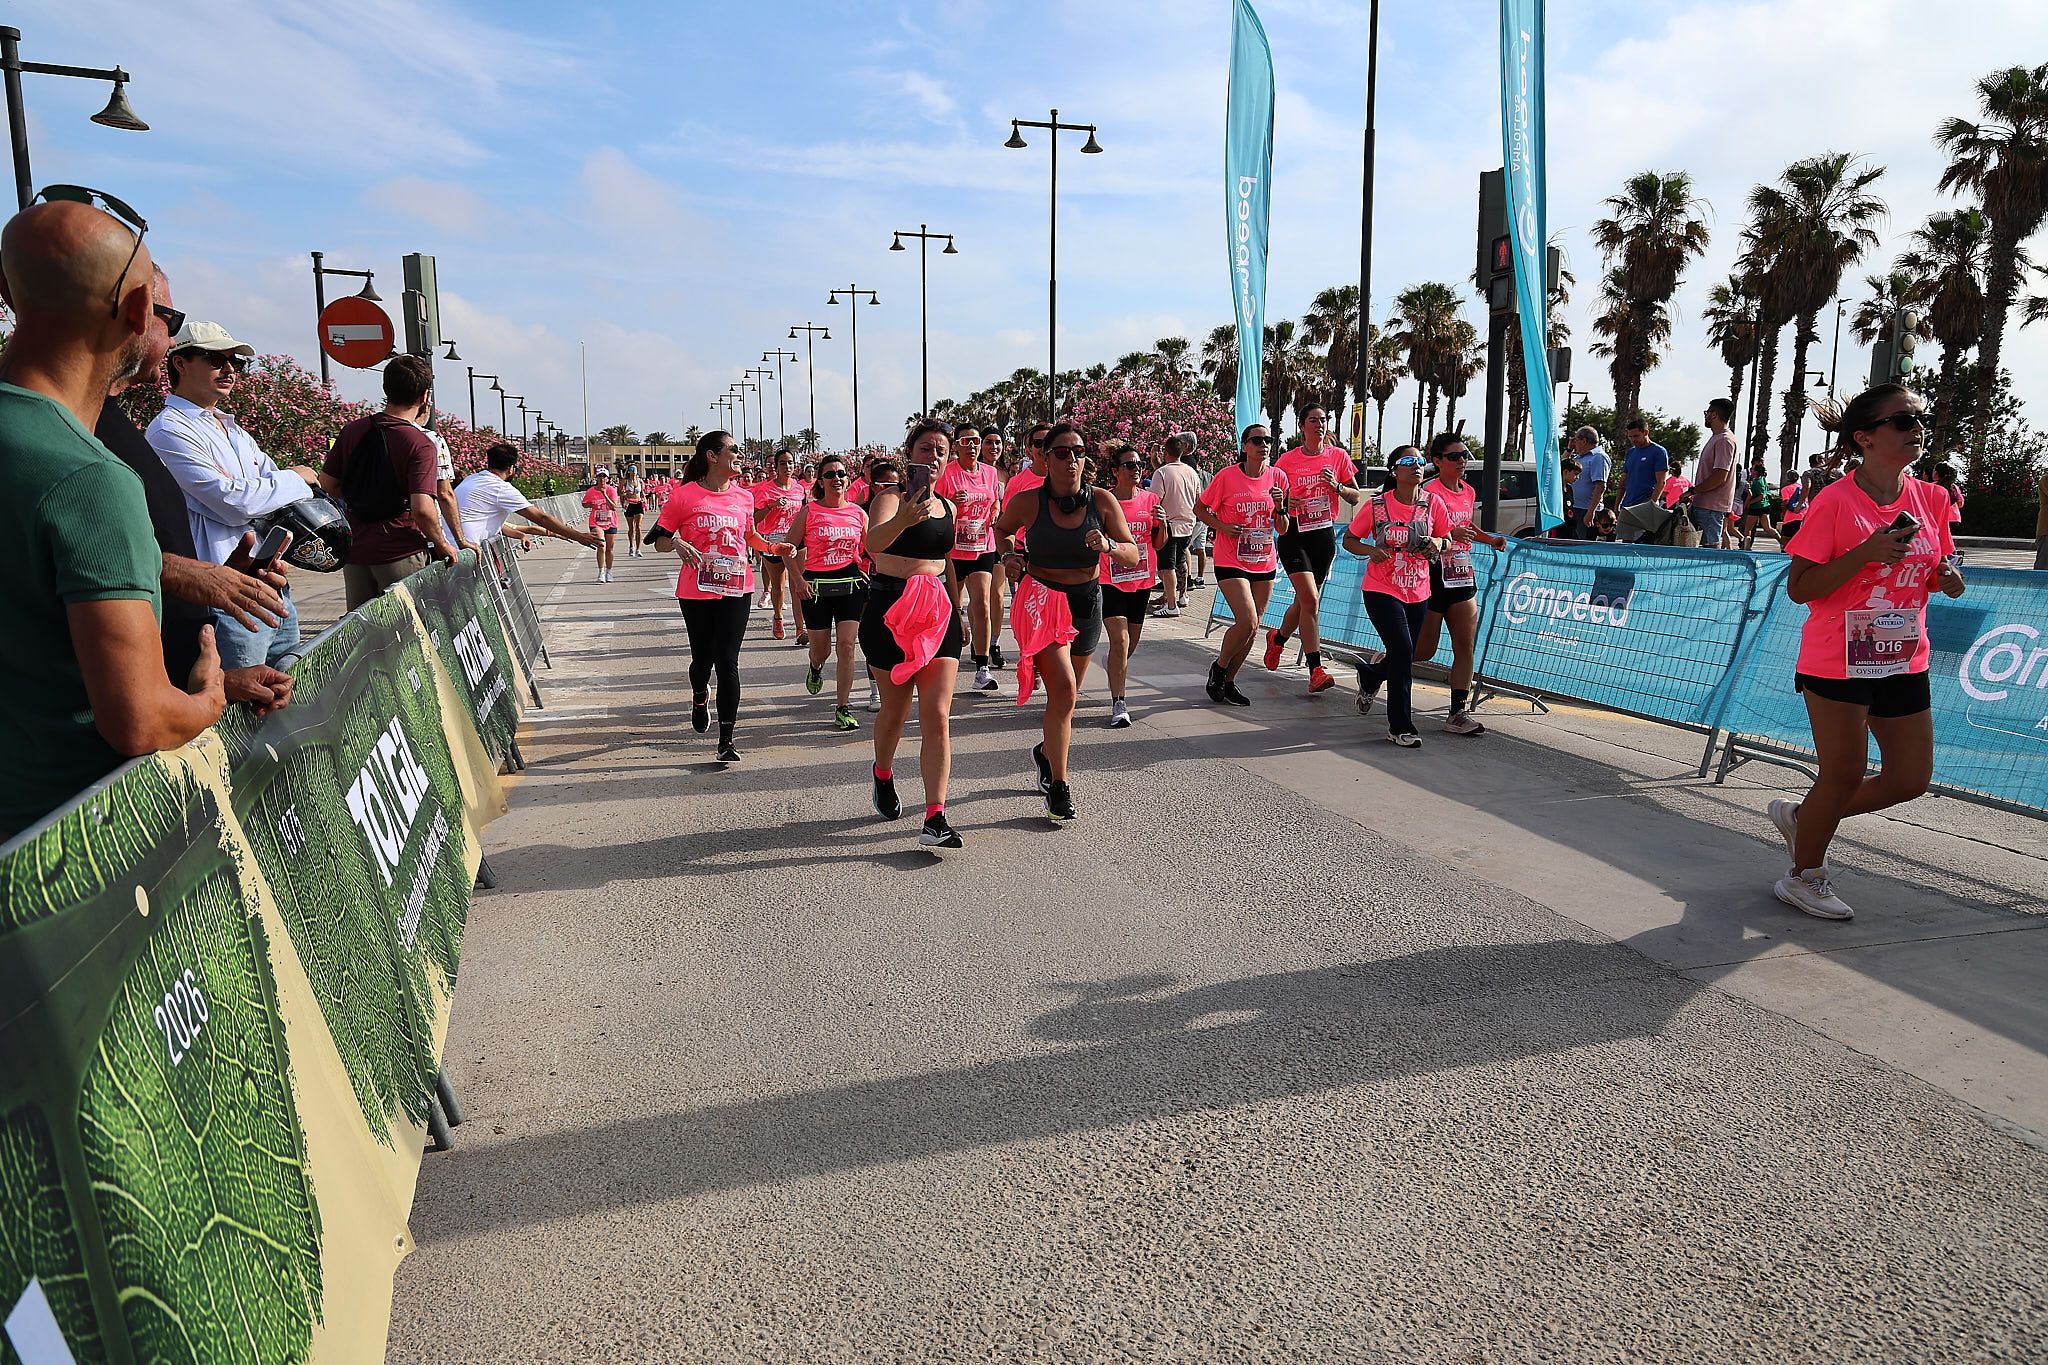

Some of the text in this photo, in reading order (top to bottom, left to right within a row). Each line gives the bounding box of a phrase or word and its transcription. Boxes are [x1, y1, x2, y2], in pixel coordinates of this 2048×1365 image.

[1297, 475, 1320, 487] CARRE
[697, 515, 739, 528] CARRERA
[1256, 514, 1265, 528] DE
[1308, 511, 1322, 519] 016
[818, 527, 857, 537] CARRERA
[1385, 529, 1408, 541] CARR
[721, 531, 734, 547] DE
[1455, 566, 1469, 574] 016
[1896, 562, 1924, 588] DE
[713, 573, 731, 581] 016
[1392, 573, 1418, 588] MUJER
[1503, 572, 1635, 627] Compeed
[1537, 630, 1580, 647] AMPOLLAS
[1875, 640, 1903, 653] 016
[278, 803, 305, 859] 1975
[154, 968, 209, 1067] 2026
